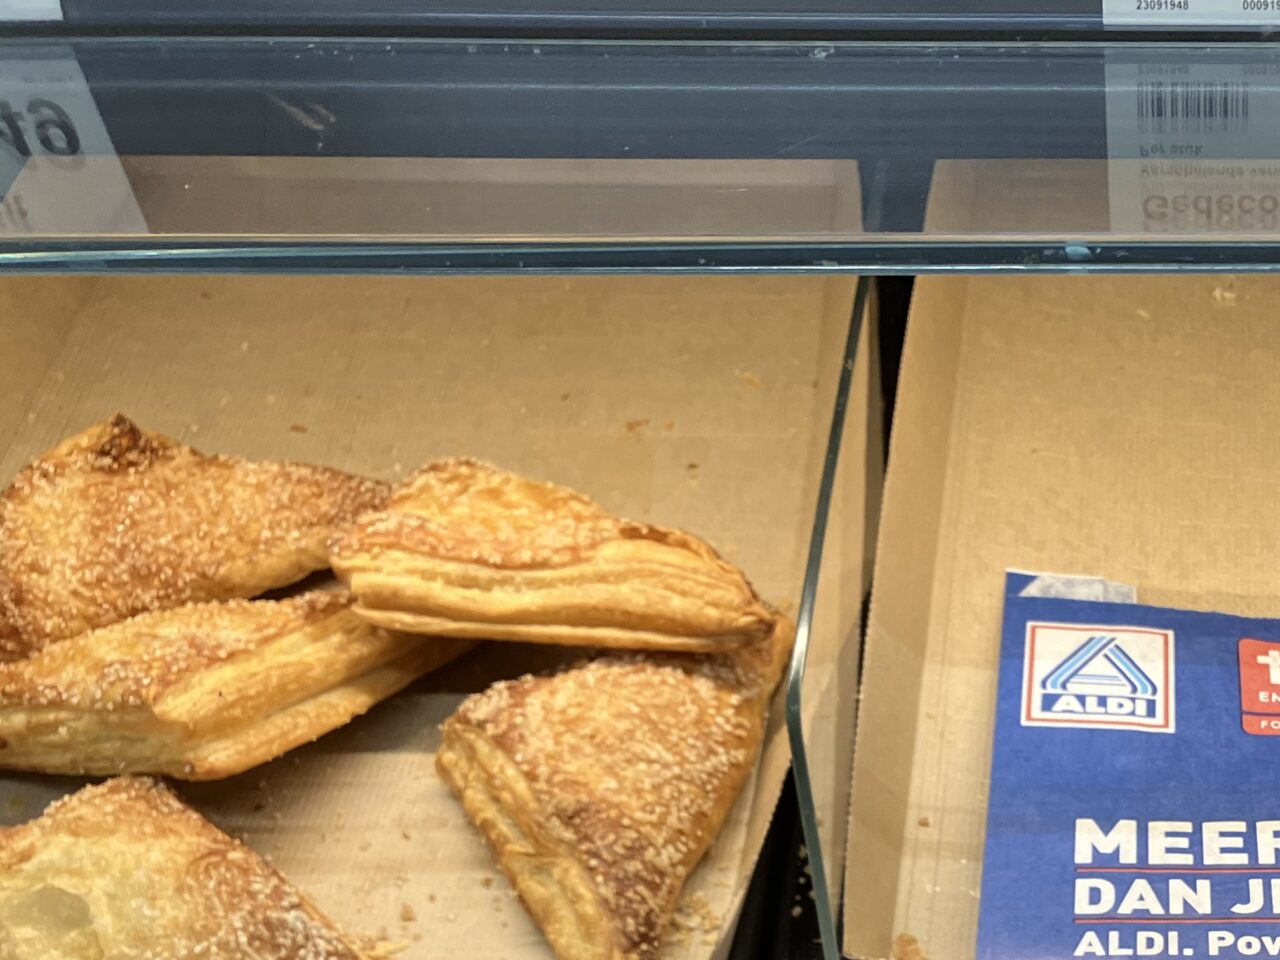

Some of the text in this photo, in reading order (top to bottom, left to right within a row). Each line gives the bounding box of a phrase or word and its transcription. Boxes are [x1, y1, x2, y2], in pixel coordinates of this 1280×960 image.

[1051, 694, 1147, 717] ALDI
[1074, 877, 1212, 915] DAN
[1073, 931, 1194, 957] ALDI.
